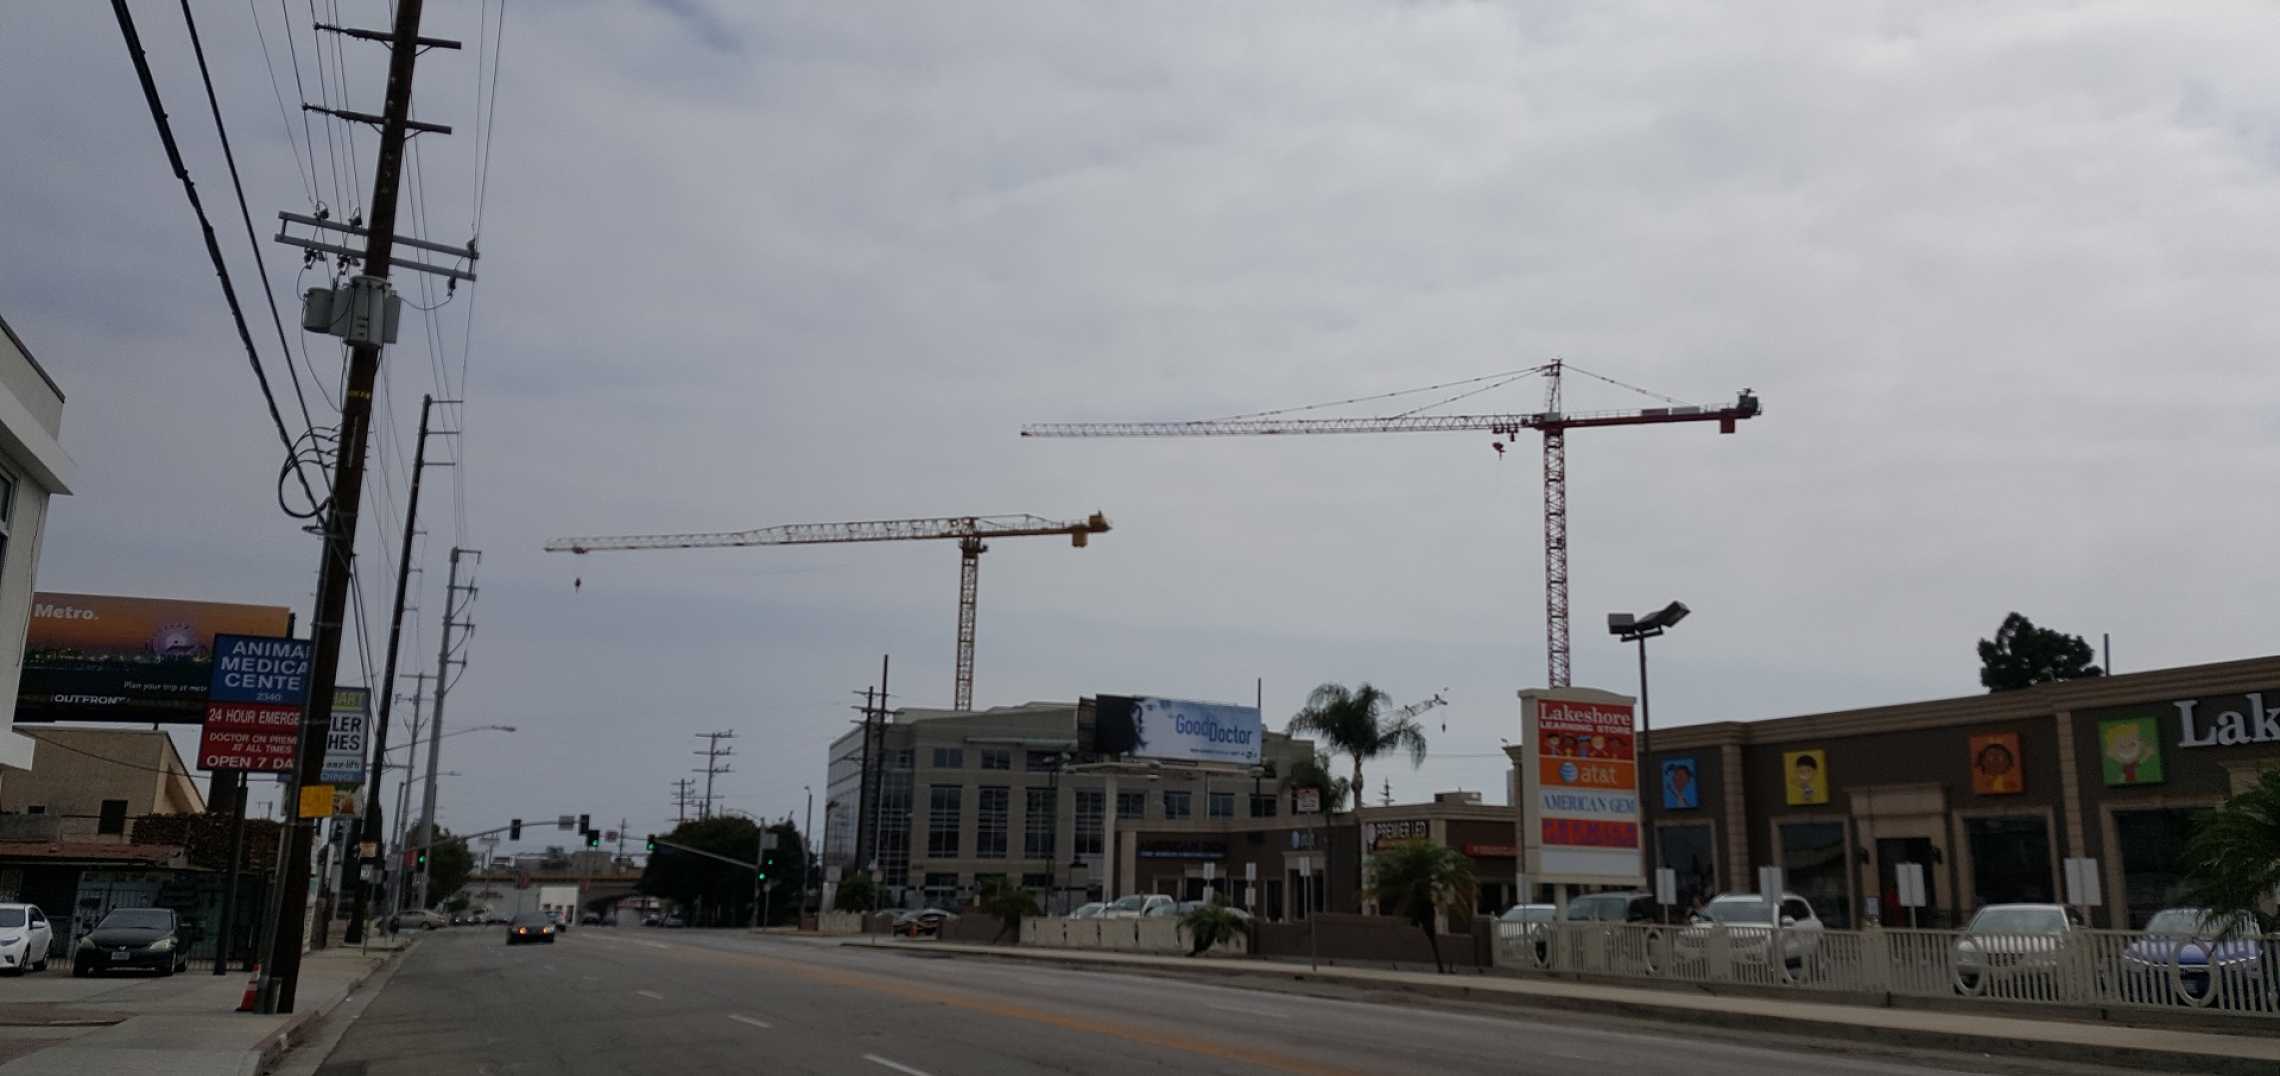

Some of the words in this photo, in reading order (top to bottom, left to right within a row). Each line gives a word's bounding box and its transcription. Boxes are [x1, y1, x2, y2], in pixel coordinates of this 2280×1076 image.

[124, 680, 143, 689] Plan
[224, 673, 302, 690] CENTE
[209, 708, 223, 721] 24
[225, 709, 256, 723] HOUR
[1540, 703, 1631, 726] Lakeshore
[2172, 692, 2280, 748] Lak
[209, 733, 249, 743] DOCTOR
[246, 744, 262, 752] ALL
[266, 744, 292, 754] TIMES
[206, 756, 251, 767] OPEN
[256, 757, 267, 769] 7
[1580, 764, 1617, 784] at&t
[1543, 794, 1608, 812] AMERICAN
